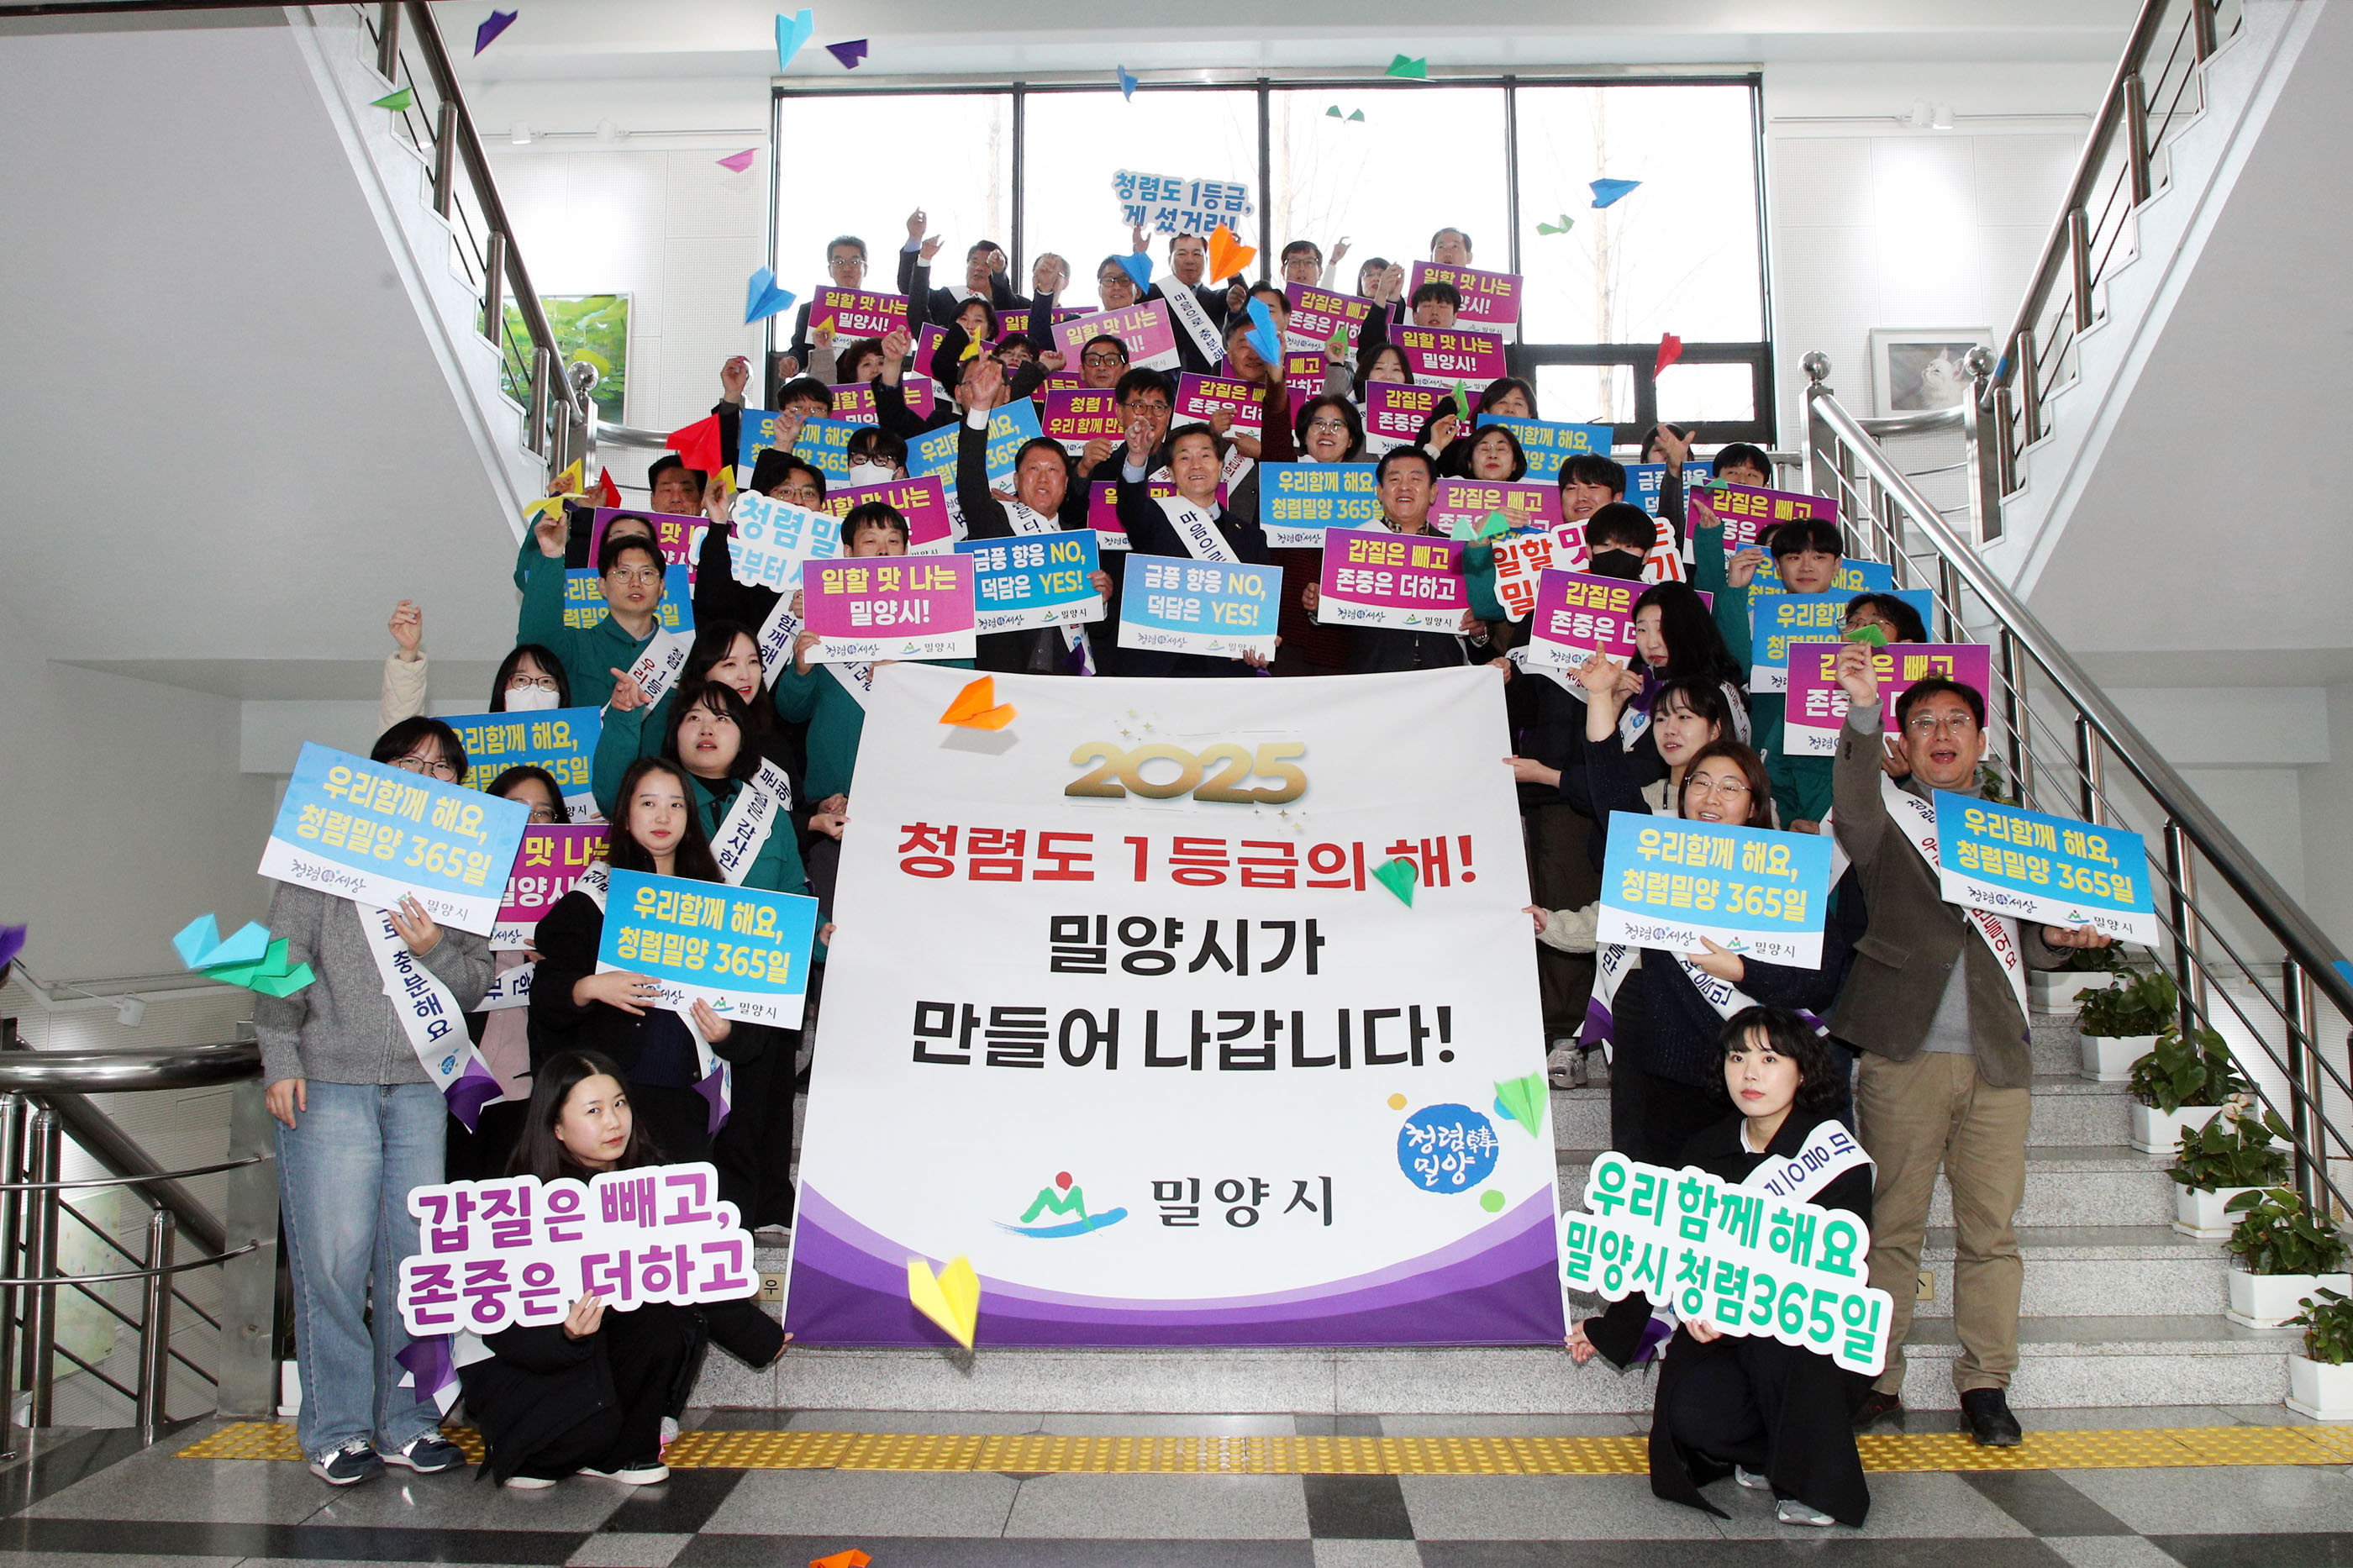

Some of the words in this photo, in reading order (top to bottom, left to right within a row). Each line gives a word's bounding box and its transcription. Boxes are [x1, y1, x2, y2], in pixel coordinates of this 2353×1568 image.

[1114, 172, 1182, 202] 청렴도
[1191, 182, 1251, 213] 1등급,
[1461, 274, 1476, 292] 맛
[1480, 276, 1512, 297] 나는
[825, 291, 855, 309] 일할
[860, 296, 874, 312] 맛
[1301, 292, 1344, 315] 갑질은
[838, 312, 889, 332] 밀양시!
[1066, 323, 1098, 346] 일할
[1103, 319, 1119, 335] 맛
[1124, 311, 1158, 331] 나는
[1288, 310, 1331, 334] 존중은
[1403, 331, 1434, 348] 일할
[1440, 334, 1456, 350] 맛
[1461, 335, 1493, 353] 나는
[1422, 352, 1477, 371] 밀양시!
[1070, 397, 1104, 413] 청렴
[1199, 381, 1248, 400] 갑질은
[1387, 390, 1432, 411] 갑질은
[1050, 418, 1073, 434] 우리
[1077, 418, 1103, 434] 함께
[1378, 412, 1424, 433] 존중은
[1558, 429, 1592, 454] 해요,
[1278, 471, 1339, 492] 우리함께
[888, 487, 930, 510] 나는
[1271, 498, 1333, 519] 청렴밀양
[1448, 487, 1501, 511] 갑질은
[1507, 492, 1543, 513] 빼고
[1713, 489, 1768, 518] 갑질은
[661, 523, 682, 545] 맛
[739, 497, 805, 550] 청렴
[1722, 518, 1757, 544] 중은
[1011, 543, 1045, 568] 향응
[1050, 540, 1086, 565] NO,
[1349, 539, 1405, 566] 갑질은
[1412, 545, 1450, 570] 빼고
[1492, 539, 1554, 578] 일할
[821, 567, 870, 594] 일할
[877, 566, 901, 592] 맛
[910, 565, 957, 592] 나는
[981, 574, 1031, 601] 덕담은
[1039, 570, 1083, 594] YES!
[1187, 568, 1222, 593] 향응
[1228, 572, 1266, 602] NO,
[1336, 568, 1393, 596] 존중은
[1399, 574, 1455, 601] 더하고
[1147, 594, 1201, 622] 덕담은
[1211, 600, 1259, 626] YES!
[1566, 581, 1630, 613] 갑질은
[850, 599, 929, 627] 밀양시!
[1061, 608, 1087, 619] 밀양시
[1424, 616, 1452, 628] 밀양시
[1550, 609, 1615, 642] 존중은
[761, 613, 797, 673] 함께해
[924, 641, 956, 652] 밀양시
[1903, 655, 1954, 681] 빼고
[531, 721, 578, 751] 해요,
[1064, 741, 1308, 805] 2025
[324, 766, 429, 823] 우리함께
[431, 796, 487, 845] 해요,
[296, 803, 403, 860] 청렴밀양
[404, 835, 493, 887] 365일
[525, 836, 555, 867] 맛
[719, 818, 756, 872] 감사한
[1965, 808, 2056, 852] 우리함께
[2062, 829, 2119, 869] 해요,
[898, 822, 1095, 882] 청렴도
[1123, 834, 1367, 892] 1등급의
[1387, 834, 1477, 889] 해!
[1636, 828, 1735, 870] 우리함께
[1742, 840, 1798, 883] 해요,
[1956, 840, 2050, 885] 청렴밀양
[2056, 862, 2135, 904] 365일
[427, 898, 469, 922] 밀양시
[1622, 868, 1720, 911] 청렴밀양
[1725, 883, 1808, 923] 365일
[634, 887, 725, 930] 우리함께
[730, 901, 783, 944] 해요,
[2093, 916, 2133, 934] 밀양시
[618, 926, 711, 970] 청렴밀양
[713, 943, 791, 984] 365일
[1050, 914, 1325, 976] 밀양시가
[1755, 941, 1796, 958] 밀양시
[393, 950, 453, 1043] 충분해요
[739, 1002, 777, 1019] 밀양시
[913, 1001, 1120, 1071] 만들어
[1145, 1004, 1455, 1071] 나갑니다!
[1414, 1151, 1476, 1187] 밀양
[419, 1186, 586, 1254] 갑질은
[601, 1173, 729, 1229] 빼고,
[1150, 1176, 1332, 1228] 밀양시
[1769, 1206, 1858, 1277] 해요
[1566, 1221, 1669, 1297] 밀양시
[408, 1259, 561, 1325] 존중은
[581, 1239, 748, 1301] 더하고
